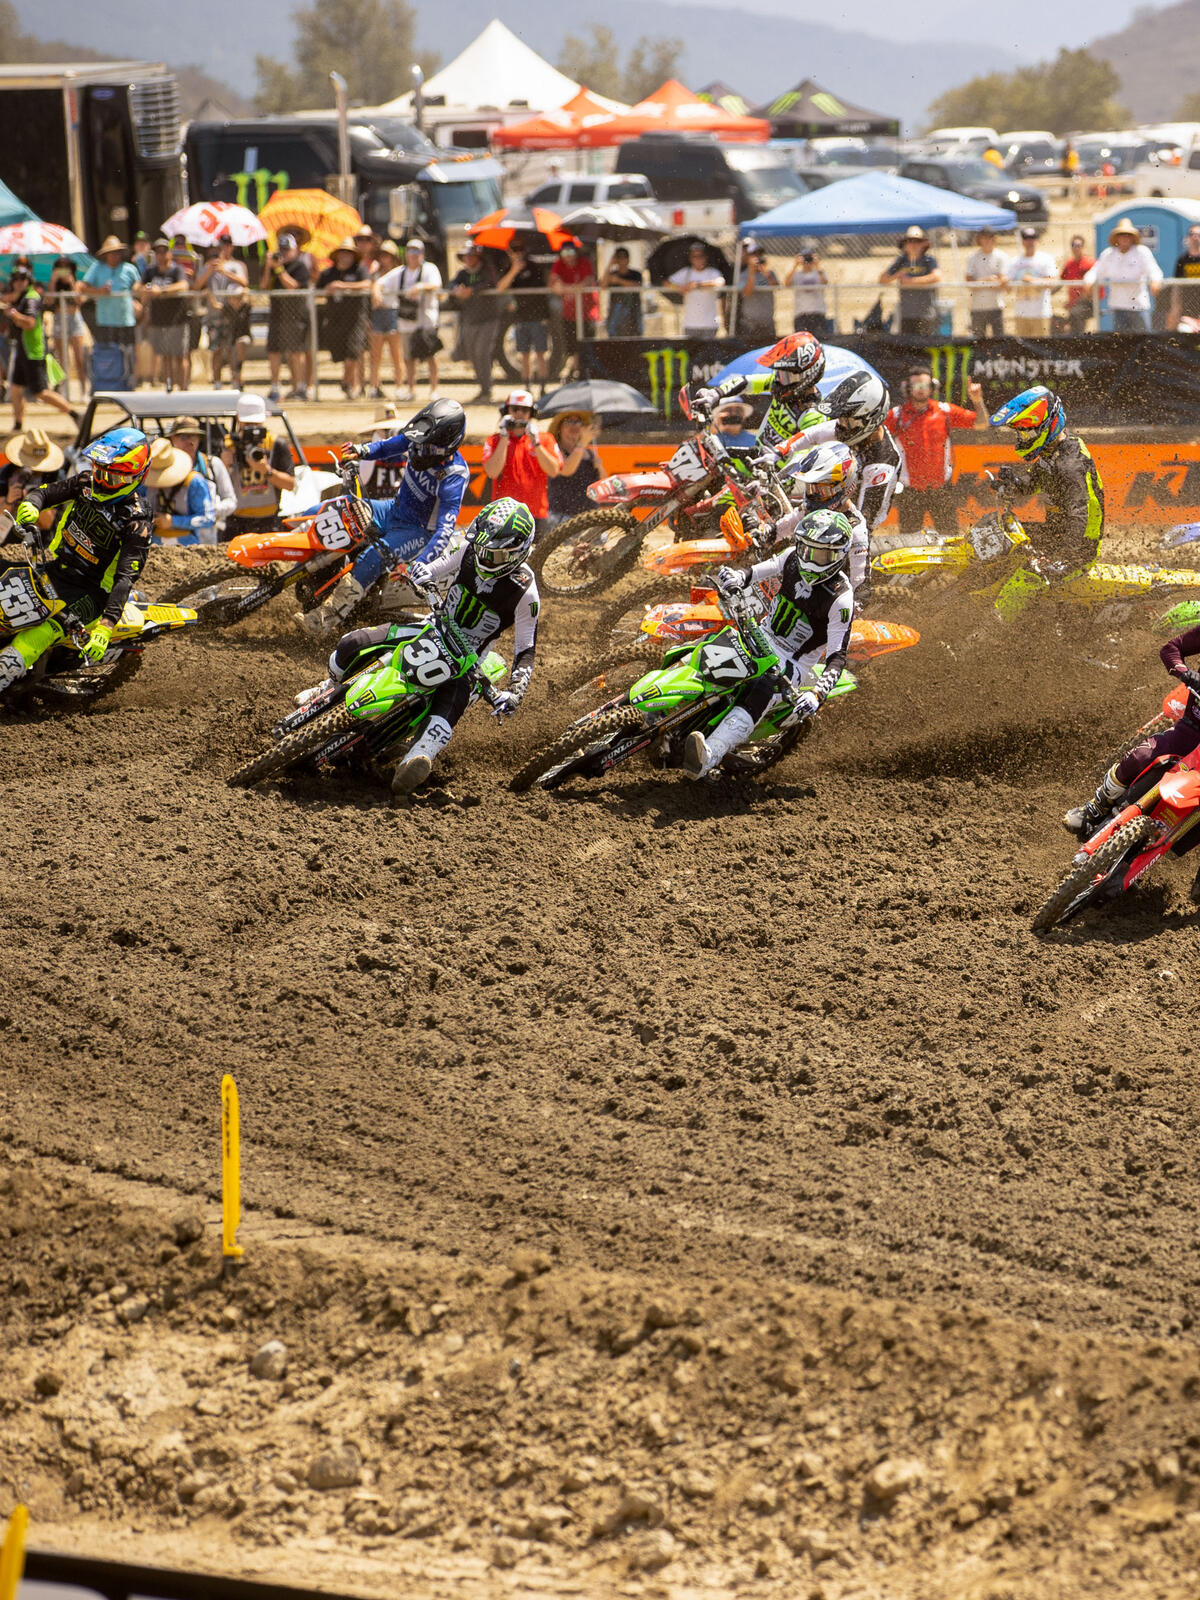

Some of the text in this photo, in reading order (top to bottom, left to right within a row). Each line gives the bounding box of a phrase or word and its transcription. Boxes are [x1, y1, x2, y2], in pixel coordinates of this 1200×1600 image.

[974, 356, 1083, 378] MONSTER
[315, 504, 351, 551] 159
[426, 512, 458, 563] CANVAS
[22, 579, 42, 608] LUCAS OIL
[94, 634, 107, 646] FLY
[433, 638, 449, 658] LUCAS
[729, 638, 744, 658] LUCAS
[403, 638, 452, 687] 30
[702, 644, 749, 680] 47
[1129, 852, 1161, 886] DUNLOP
